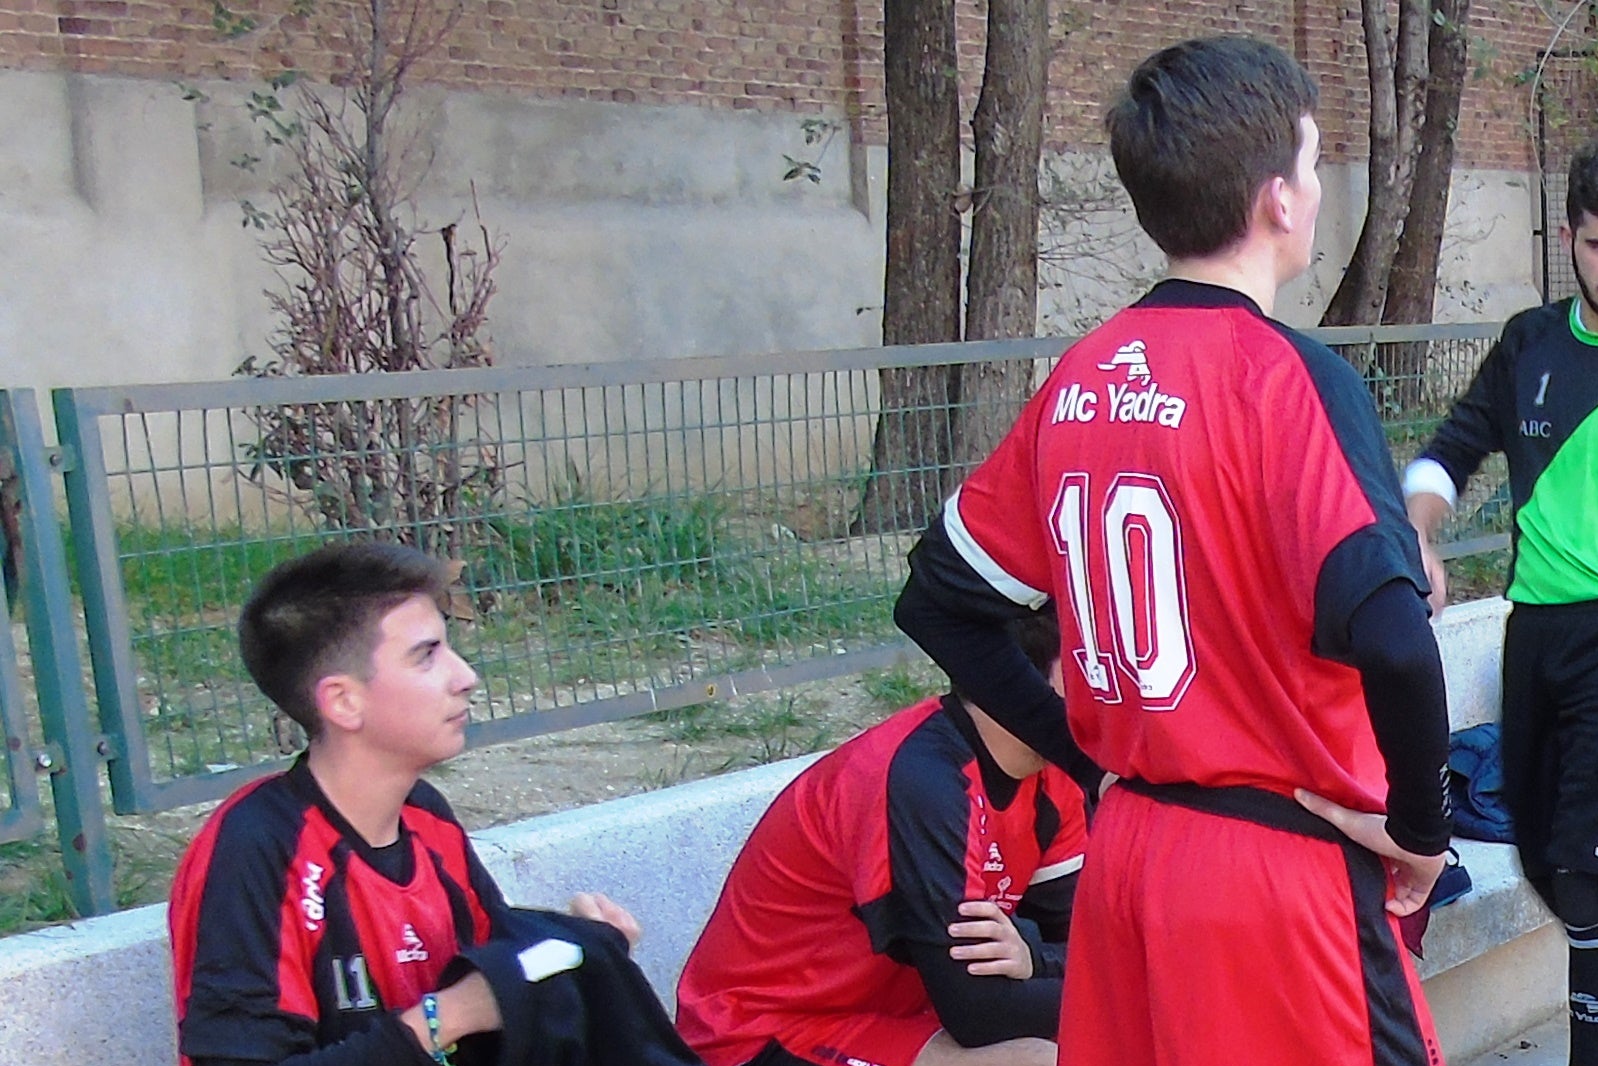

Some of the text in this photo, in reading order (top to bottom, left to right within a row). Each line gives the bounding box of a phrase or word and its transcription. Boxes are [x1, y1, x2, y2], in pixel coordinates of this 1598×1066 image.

[1051, 382, 1186, 429] Mc Yadra
[1534, 373, 1551, 406] 1
[1519, 419, 1552, 438] ABC
[1048, 472, 1198, 711] 10
